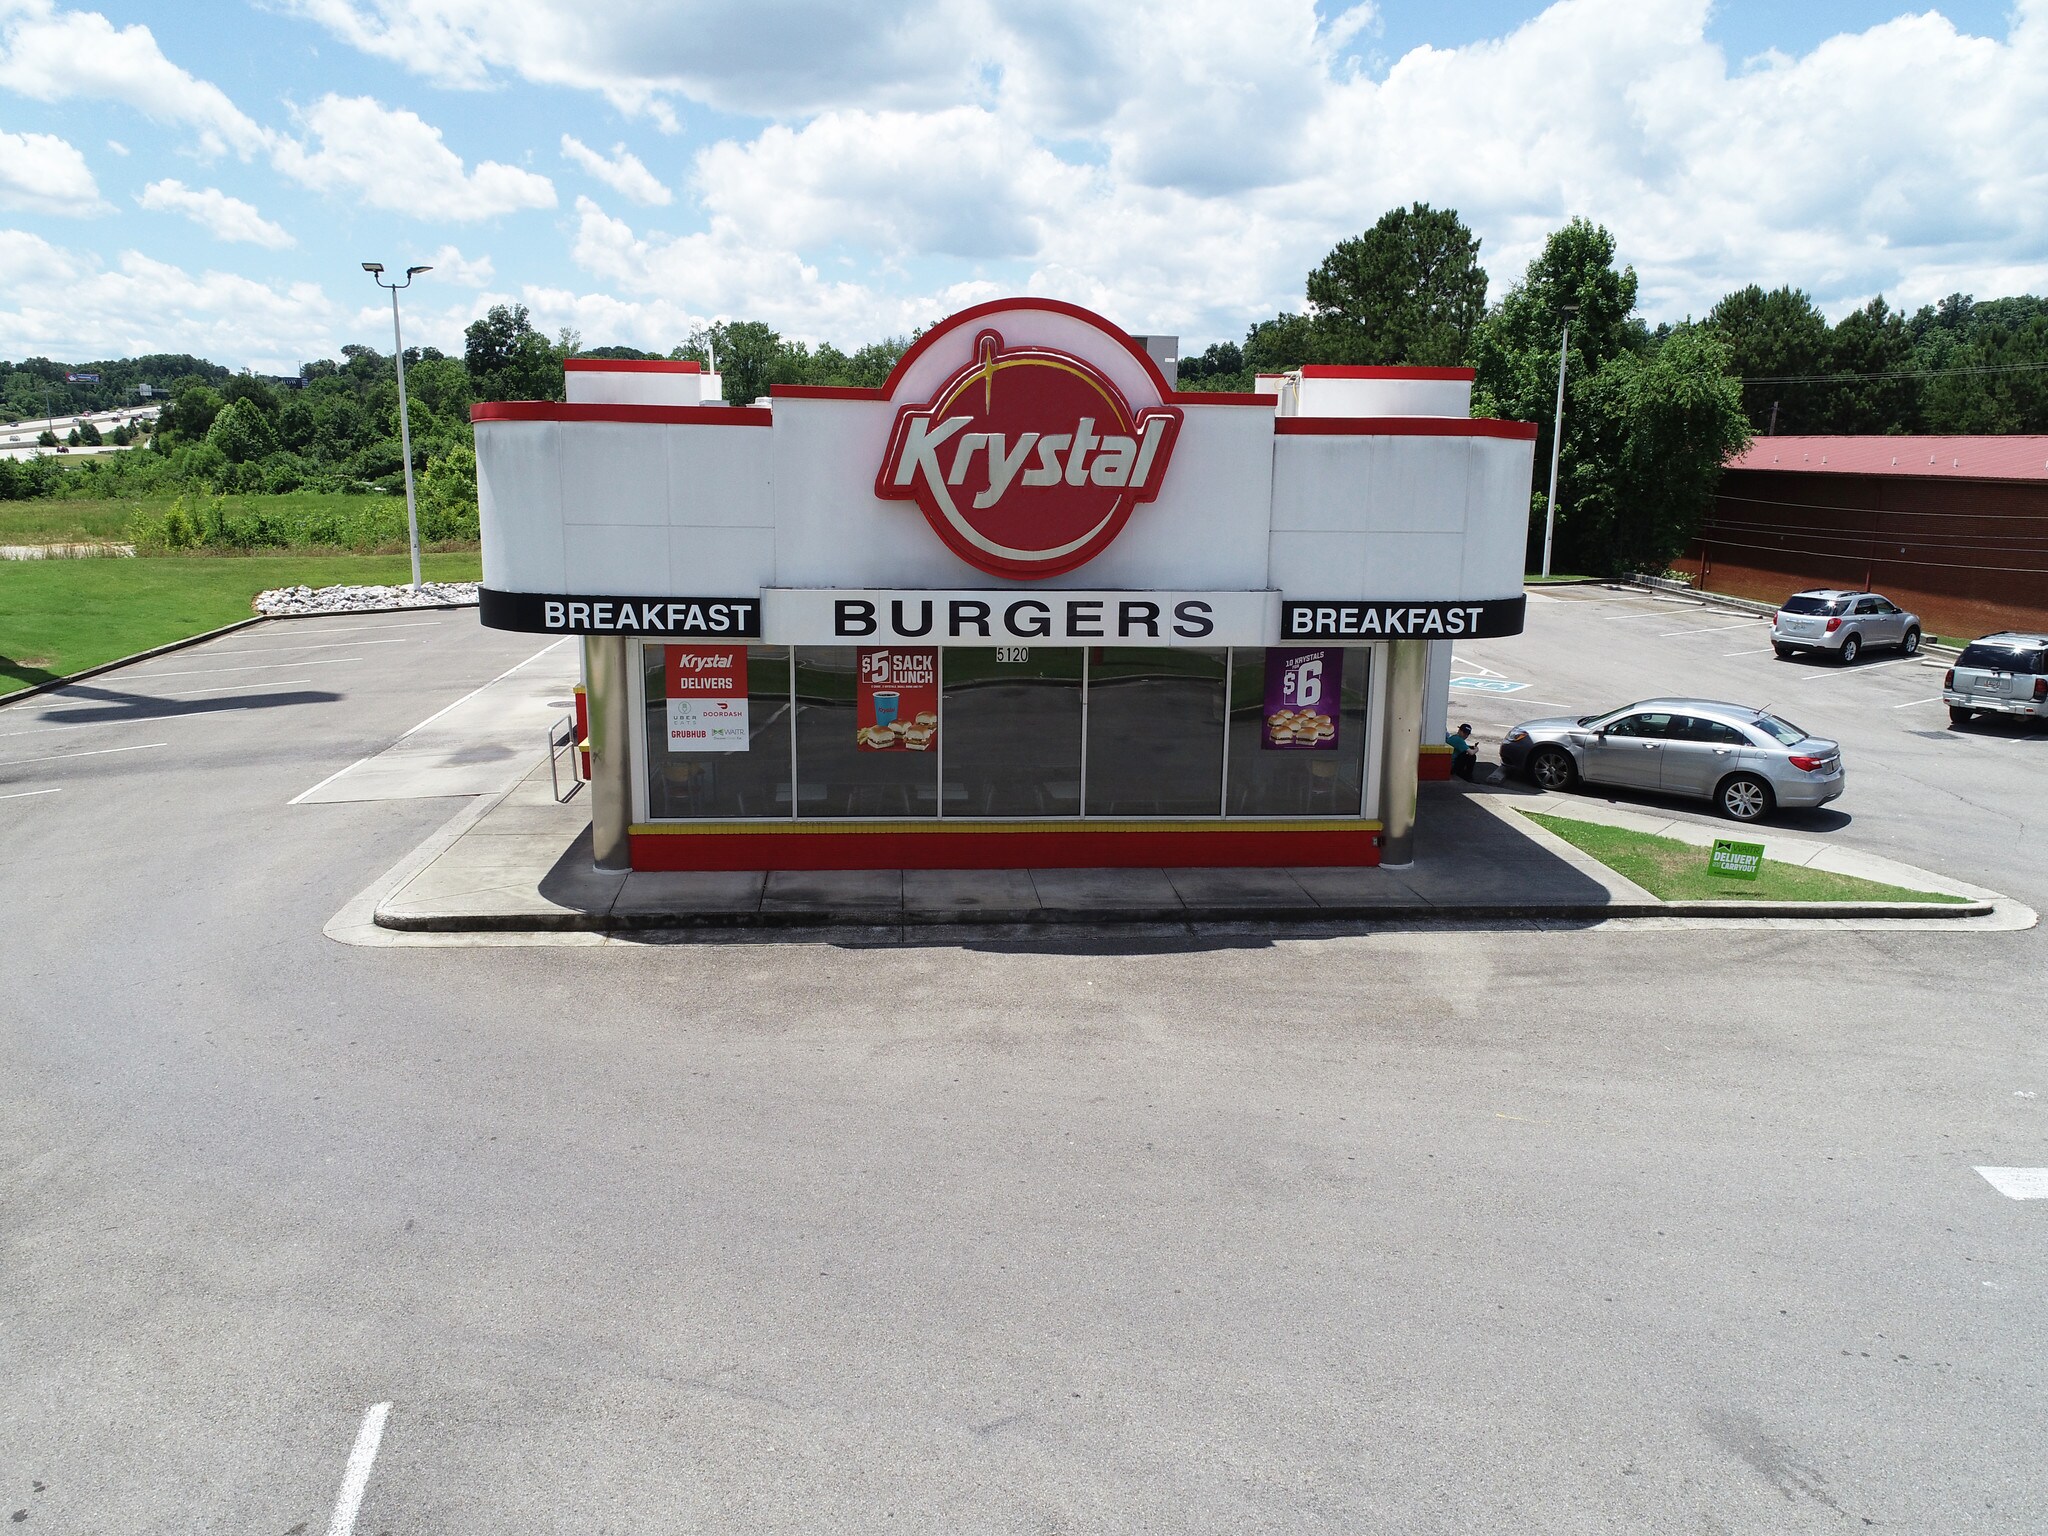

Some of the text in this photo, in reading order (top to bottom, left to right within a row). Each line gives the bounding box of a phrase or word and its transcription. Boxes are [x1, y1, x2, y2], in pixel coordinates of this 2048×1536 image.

[893, 416, 1166, 509] Krystal
[544, 601, 752, 632] BREAKFAST
[834, 599, 1214, 638] BURGERS
[1291, 606, 1483, 634] BREAKFAST
[997, 647, 1028, 662] 5120
[1285, 651, 1325, 668] 10 KRYSTALS
[679, 654, 733, 673] Krystal
[862, 650, 933, 683] $5 SACK
[680, 677, 733, 689] DELIVERS
[893, 671, 933, 684] LUNCH
[1283, 660, 1323, 707] $6
[671, 730, 707, 738] GRUBHUB
[724, 728, 745, 736] WAITR
[1732, 844, 1760, 854] WAITR
[1713, 851, 1759, 865] DELIVERY
[1721, 862, 1757, 873] CARRYOUT
